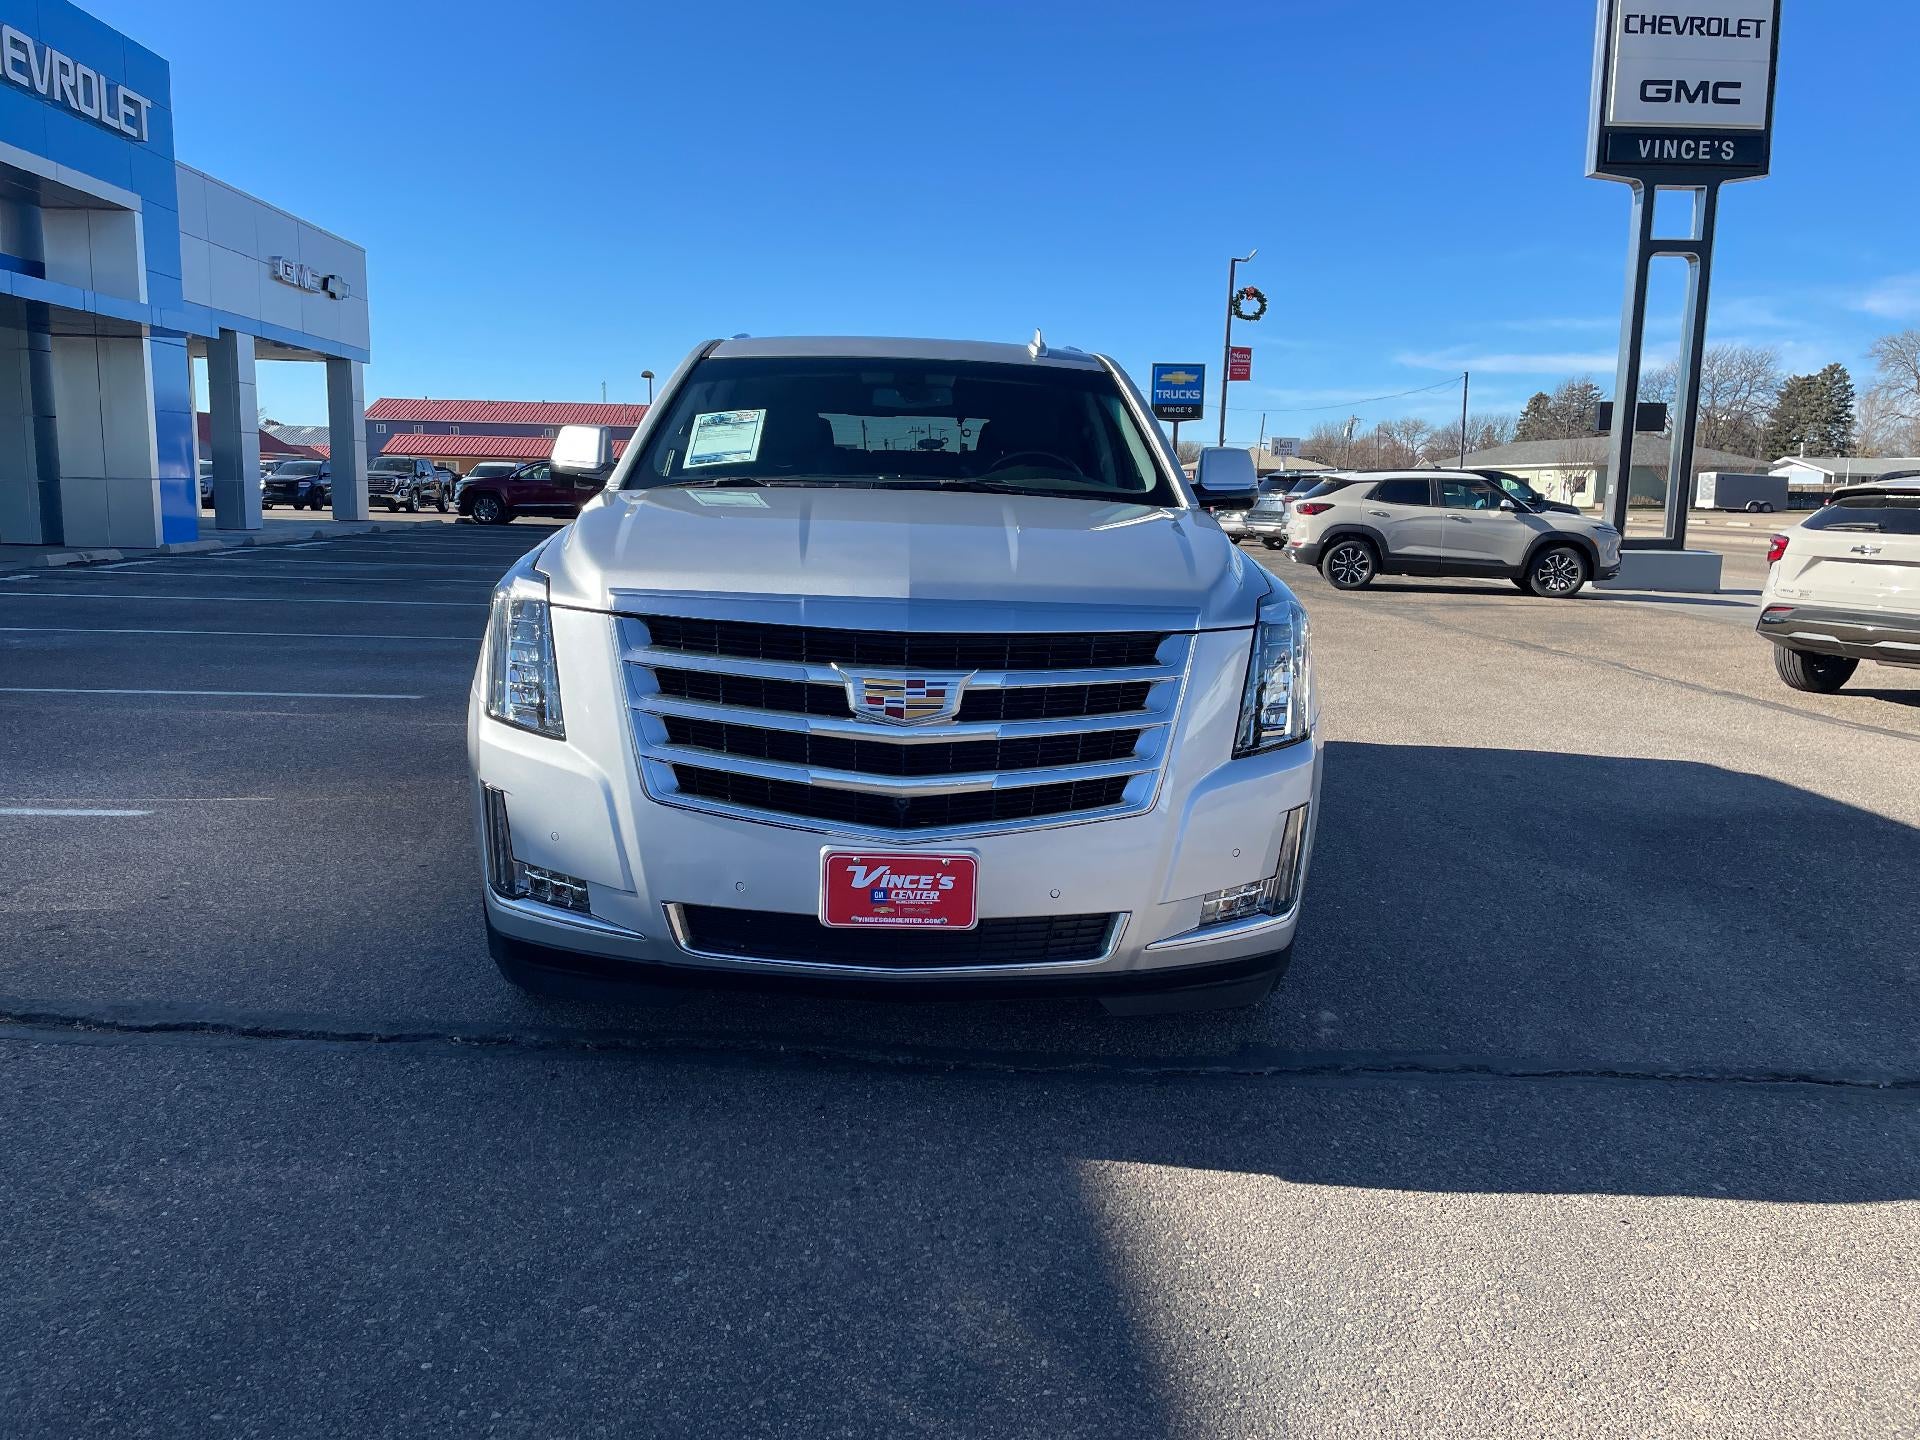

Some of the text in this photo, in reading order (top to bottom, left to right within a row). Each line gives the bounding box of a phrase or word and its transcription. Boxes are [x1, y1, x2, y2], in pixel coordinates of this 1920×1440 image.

[1624, 14, 1766, 38] CHEVROLET
[0, 23, 151, 141] EVROLET
[1639, 79, 1742, 105] GMC
[1638, 138, 1735, 160] VINCE'S
[270, 256, 320, 294] GMC
[1156, 389, 1200, 400] TRUCKS
[890, 890, 940, 900] CENTER
